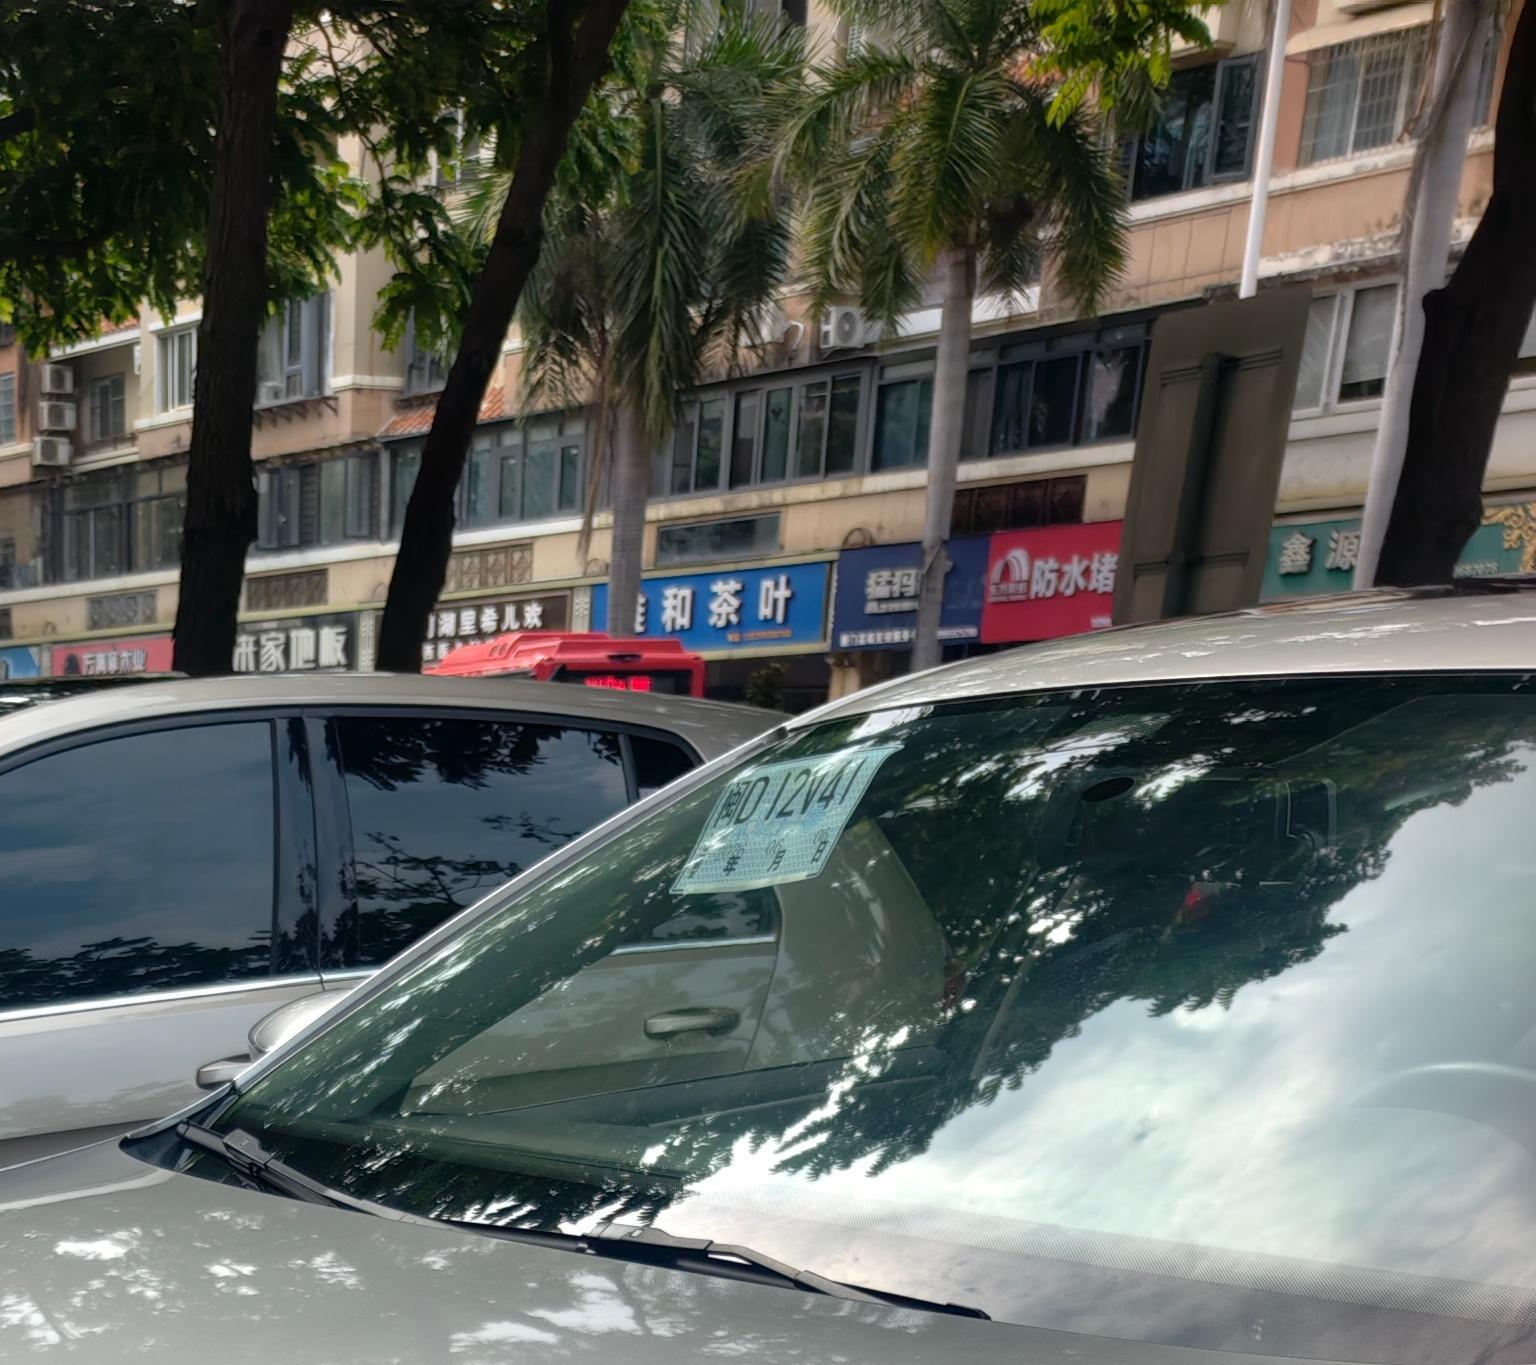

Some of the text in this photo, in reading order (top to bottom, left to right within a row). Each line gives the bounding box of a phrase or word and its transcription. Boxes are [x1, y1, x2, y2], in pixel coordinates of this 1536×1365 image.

[1279, 530, 1362, 574] 鑫源
[1030, 553, 1119, 599] 防水堵
